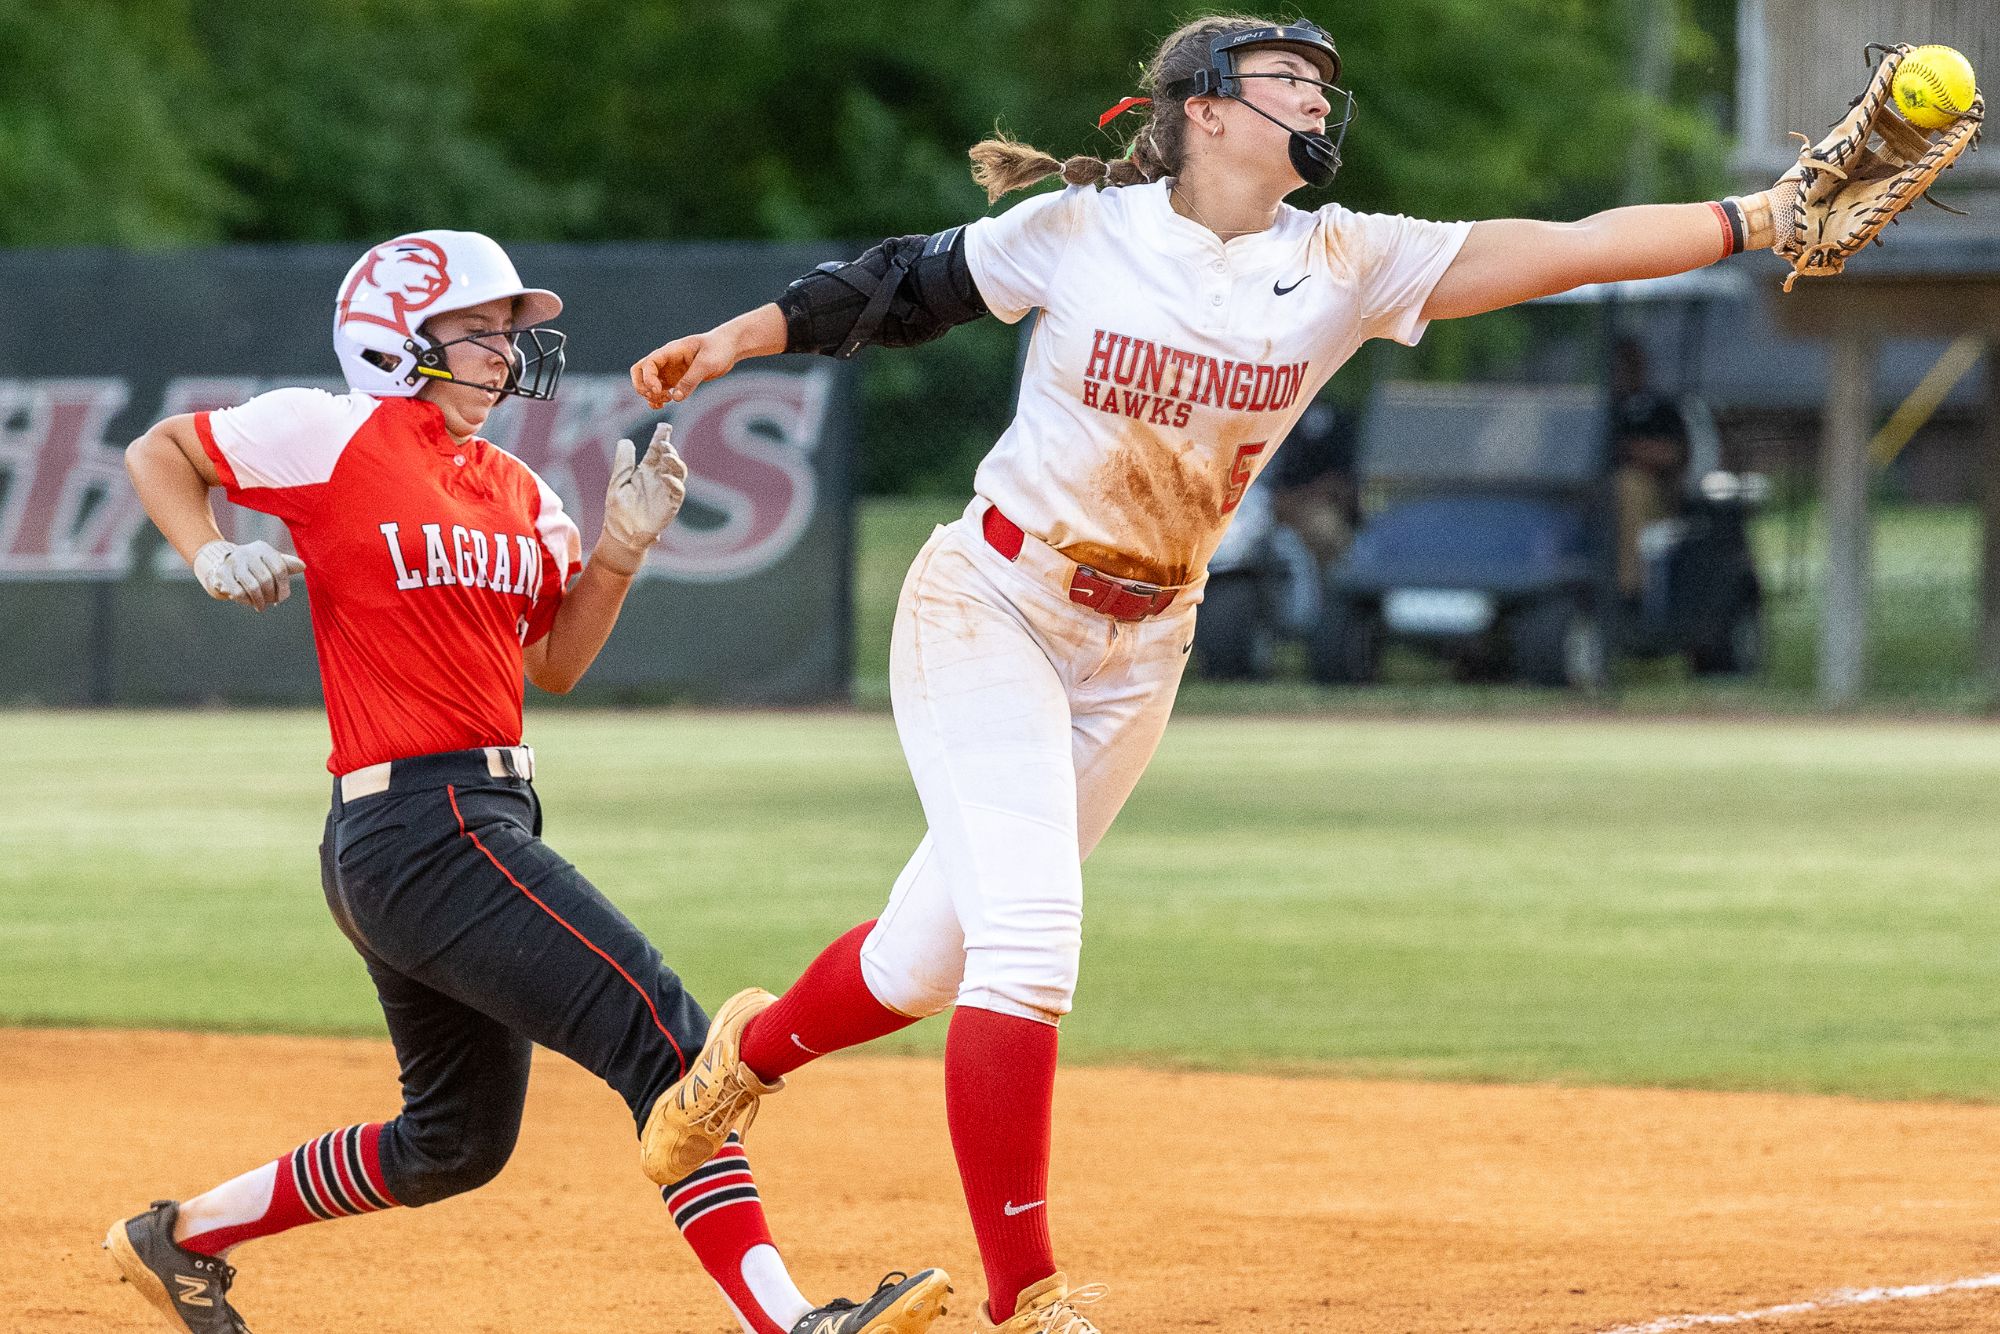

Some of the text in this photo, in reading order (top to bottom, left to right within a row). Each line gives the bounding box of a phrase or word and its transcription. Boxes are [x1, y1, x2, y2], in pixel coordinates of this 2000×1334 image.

[1082, 379, 1193, 429] HAWKS
[1085, 328, 1309, 412] HUNTINGDON
[1220, 439, 1269, 518] 5
[379, 522, 543, 609] LAGRAN
